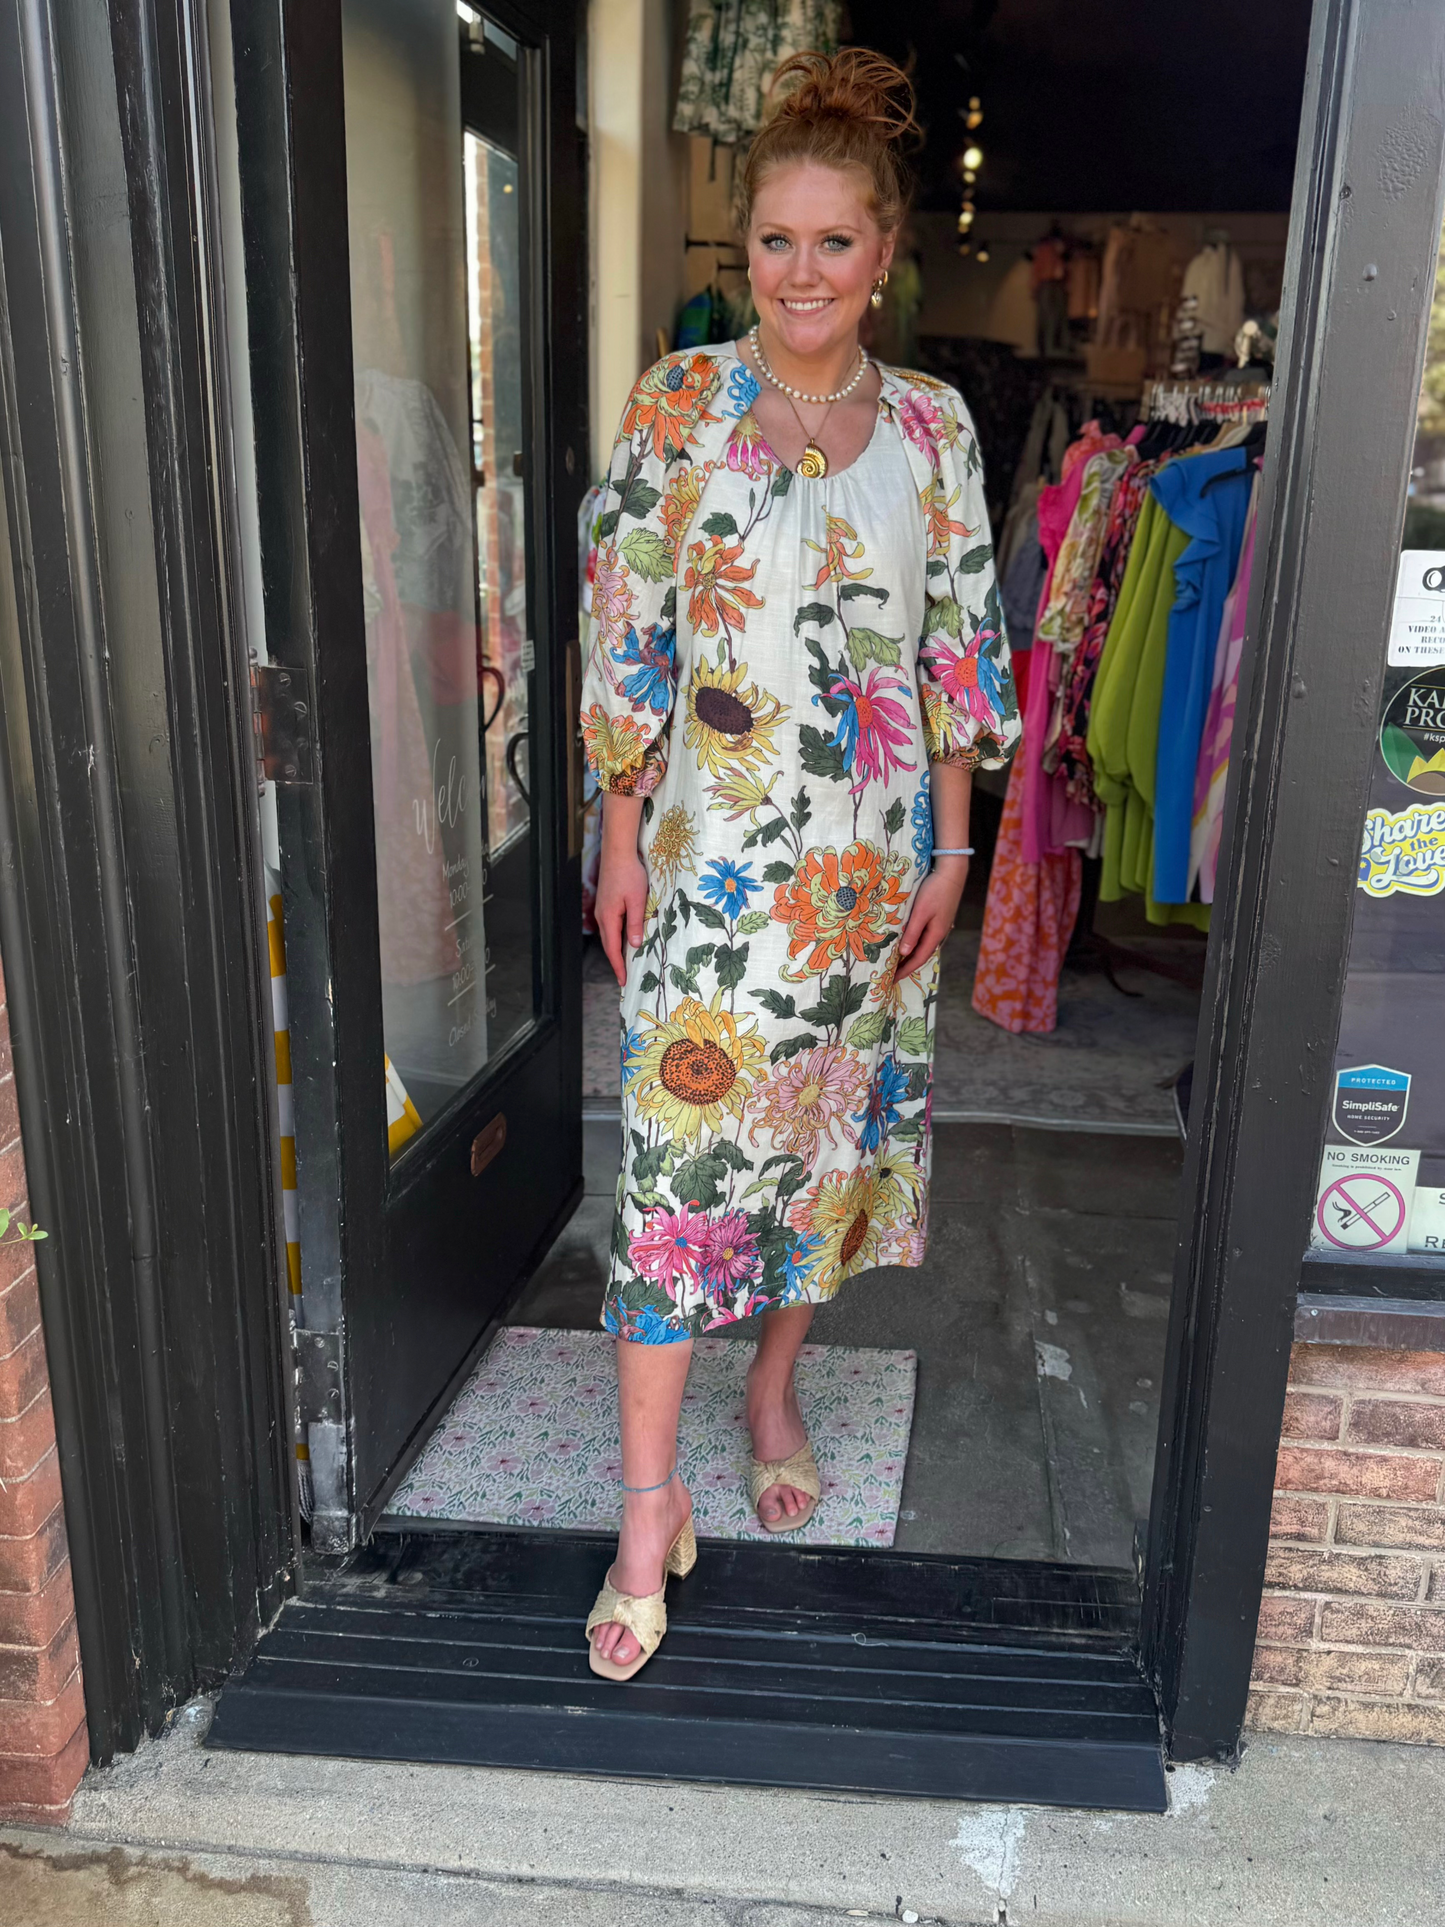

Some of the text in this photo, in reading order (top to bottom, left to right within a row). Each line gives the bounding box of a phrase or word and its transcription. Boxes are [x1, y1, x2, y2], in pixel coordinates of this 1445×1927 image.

[1408, 625, 1437, 633] VIDEO
[1398, 645, 1445, 654] ON THESE
[1407, 688, 1445, 709] KA
[1410, 836, 1438, 852] the
[1370, 845, 1445, 890] Love
[1350, 1077, 1397, 1086] PROTECTED
[1341, 1100, 1399, 1112] SimpliSafe
[1327, 1151, 1410, 1165] NO SMOKING
